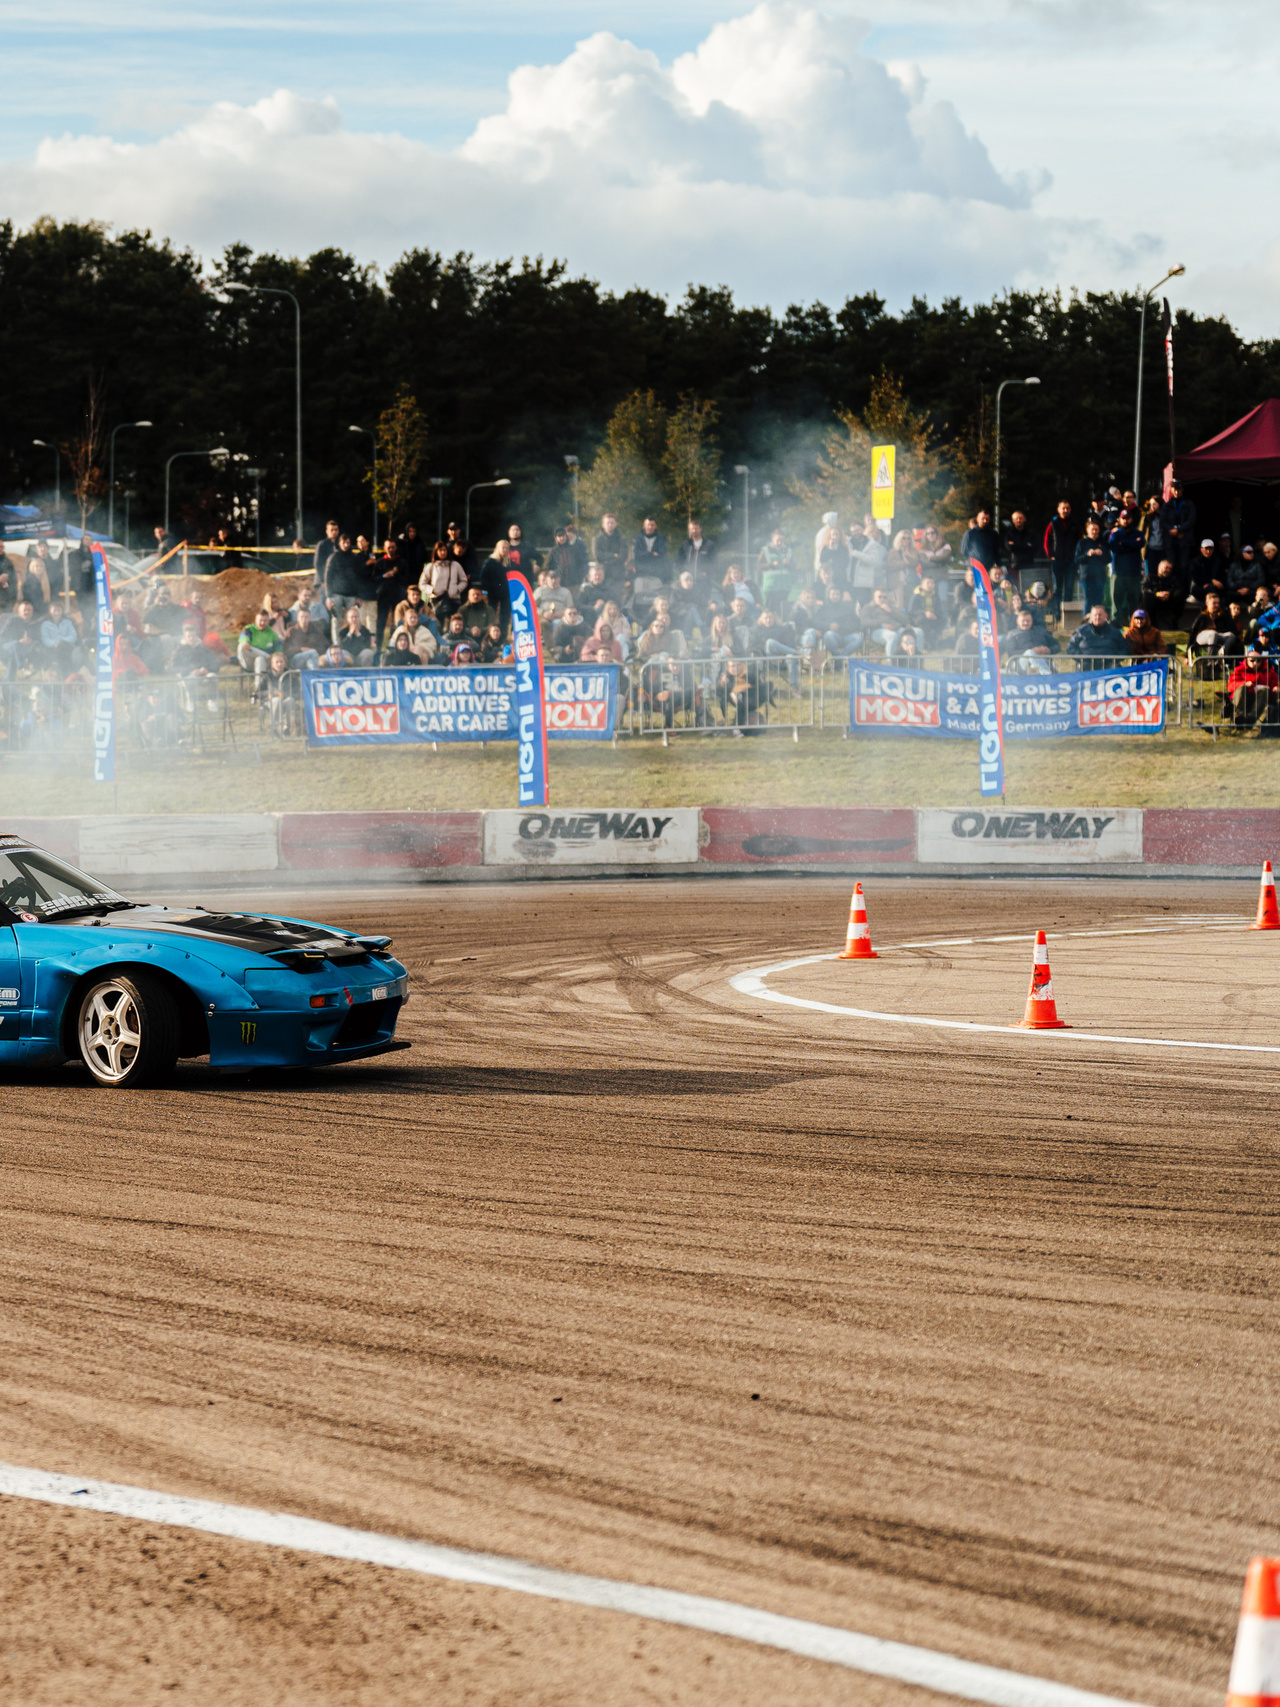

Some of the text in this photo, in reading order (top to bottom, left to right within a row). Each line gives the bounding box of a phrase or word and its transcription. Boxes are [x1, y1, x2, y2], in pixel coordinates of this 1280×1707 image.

[316, 679, 394, 707] LIQUI
[404, 674, 517, 695] MOTOR OILS
[544, 675, 605, 702] IQUI
[859, 671, 935, 702] LIQUI
[947, 681, 1072, 696] MOR OILS
[1082, 672, 1158, 702] LIQUI
[412, 695, 511, 714] ADDITIVES
[859, 698, 937, 724] MOLY
[946, 696, 962, 715] &
[1083, 698, 1160, 724] MOLY
[318, 706, 397, 734] MOLY
[415, 714, 508, 733] CAR CARE
[1005, 719, 1071, 733] Germany
